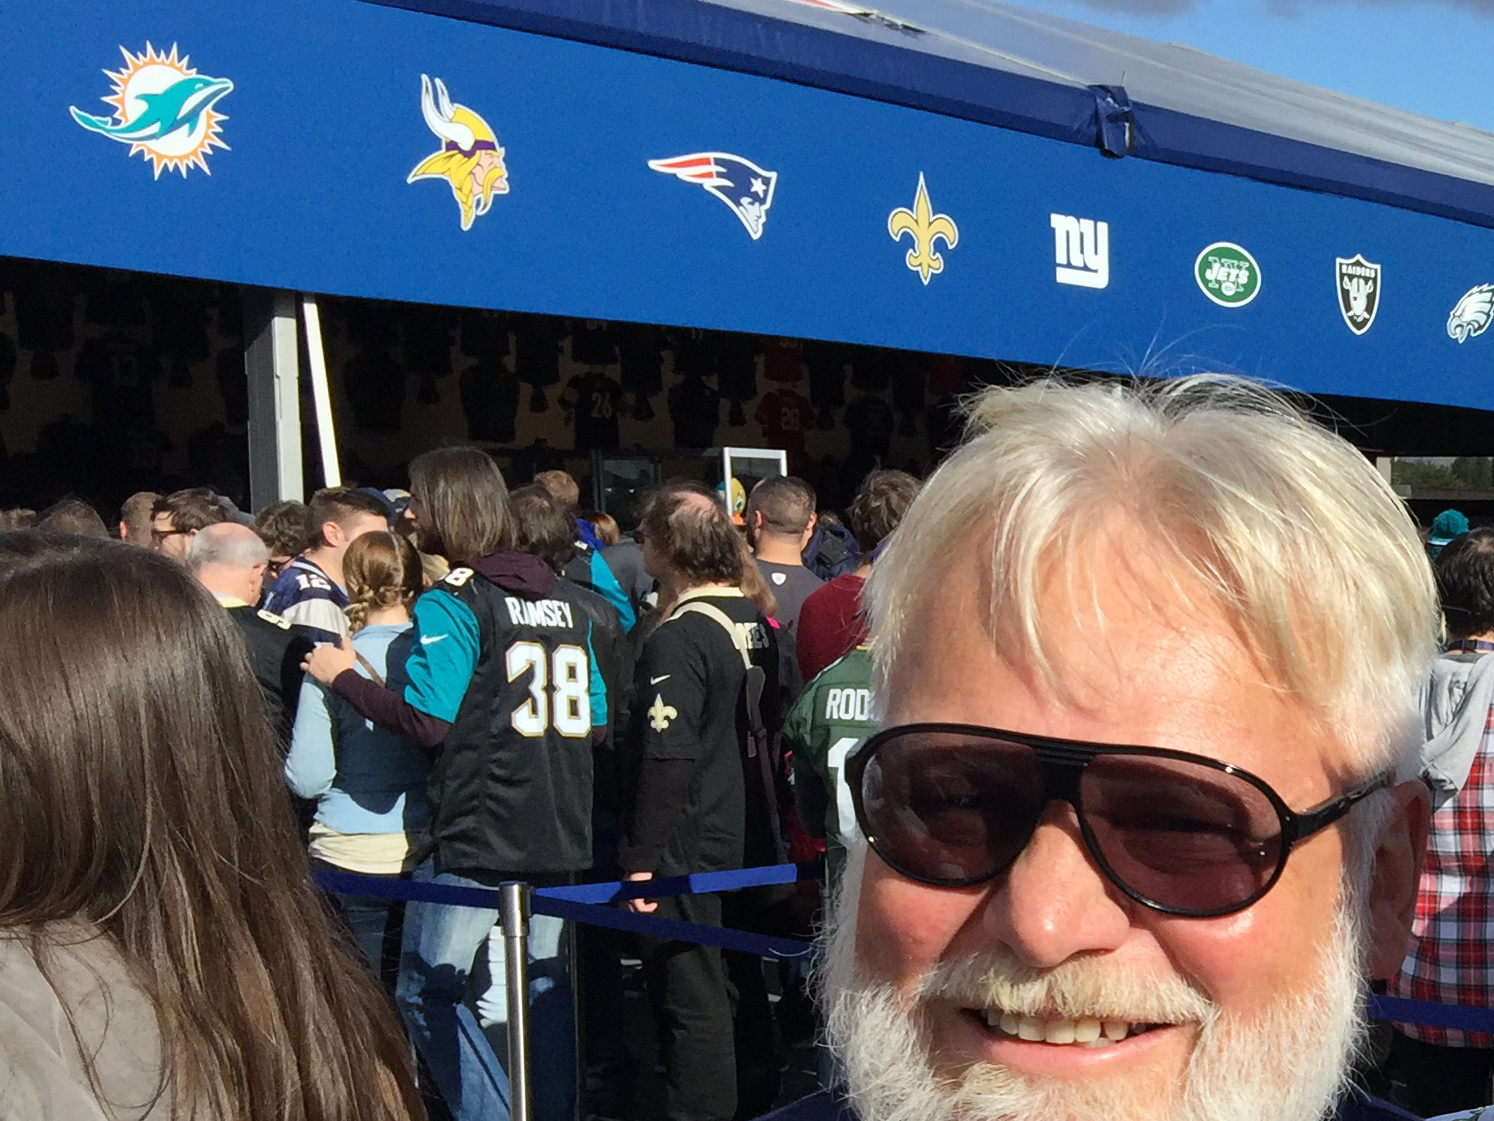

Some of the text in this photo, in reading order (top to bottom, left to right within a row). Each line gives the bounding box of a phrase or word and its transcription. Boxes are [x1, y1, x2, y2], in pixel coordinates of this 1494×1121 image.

[1205, 262, 1250, 285] JETS
[1341, 263, 1377, 279] RAIDERS
[295, 573, 332, 591] 12
[505, 640, 592, 738] 38
[825, 688, 872, 721] ROD
